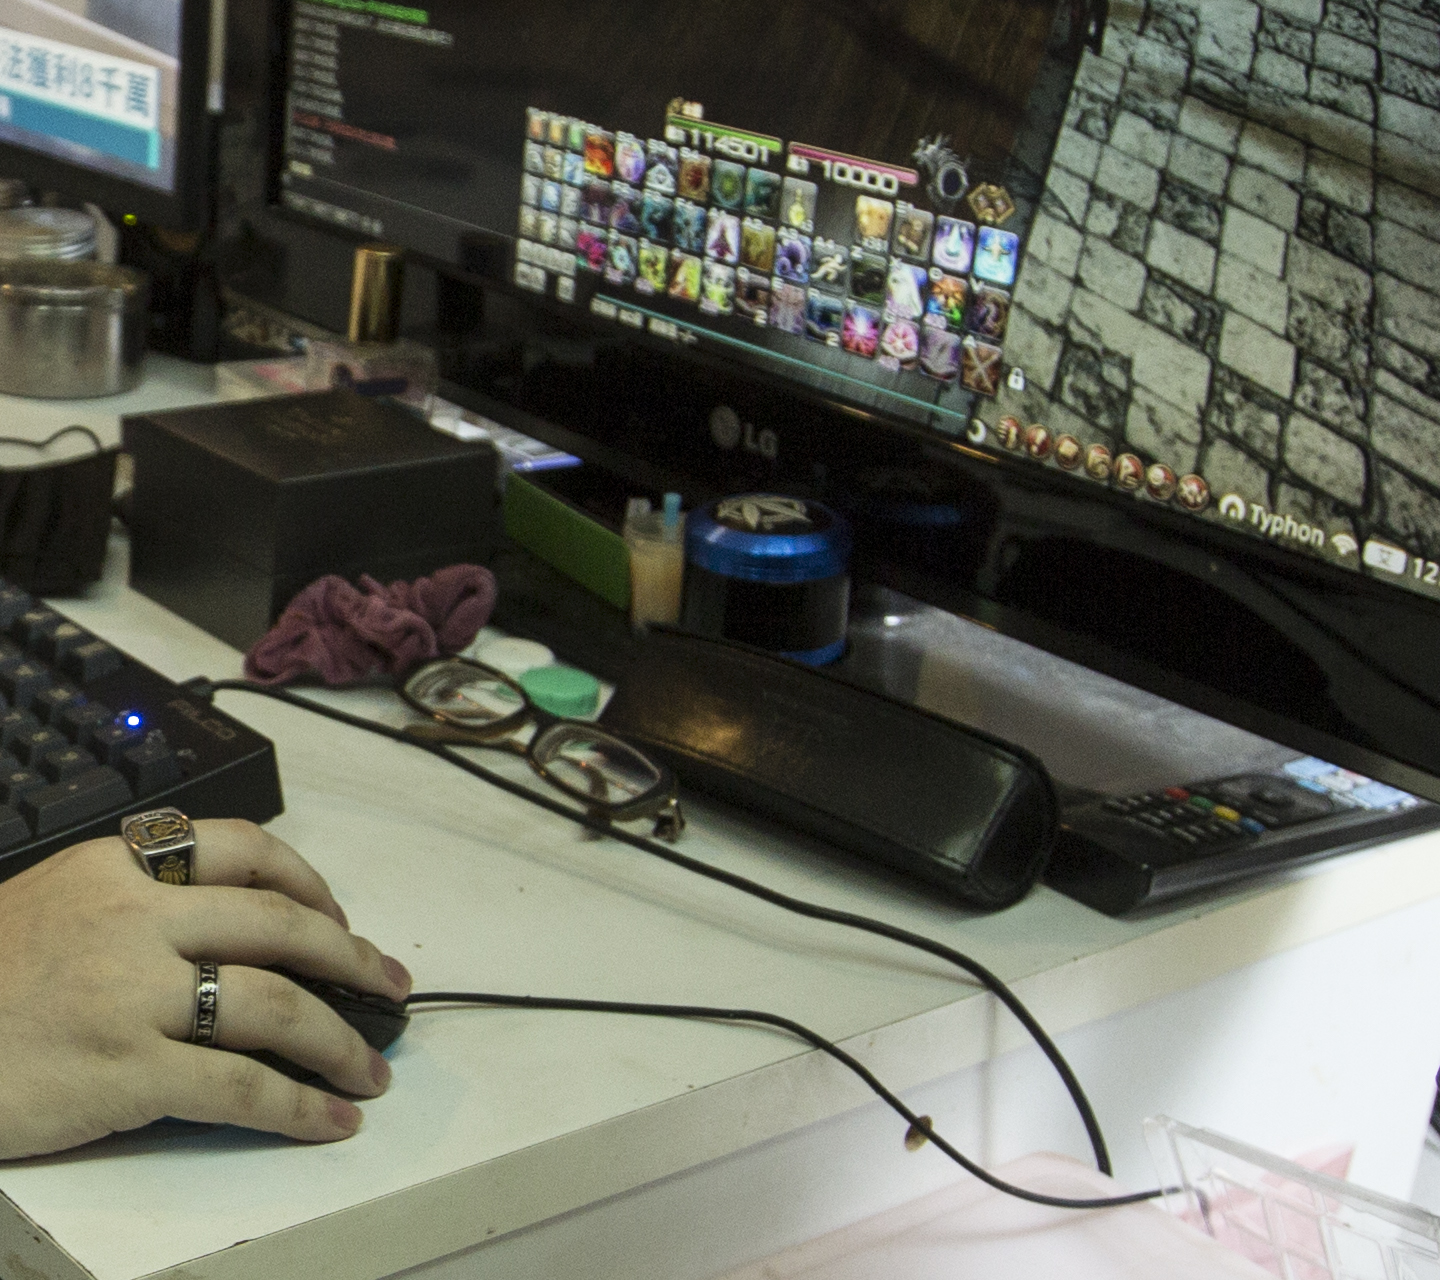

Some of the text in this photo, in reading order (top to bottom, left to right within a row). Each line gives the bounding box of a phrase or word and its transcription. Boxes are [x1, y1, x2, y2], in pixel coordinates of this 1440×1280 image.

[822, 160, 899, 197] 10000
[743, 421, 780, 459] LG
[1250, 502, 1326, 549] Typhon
